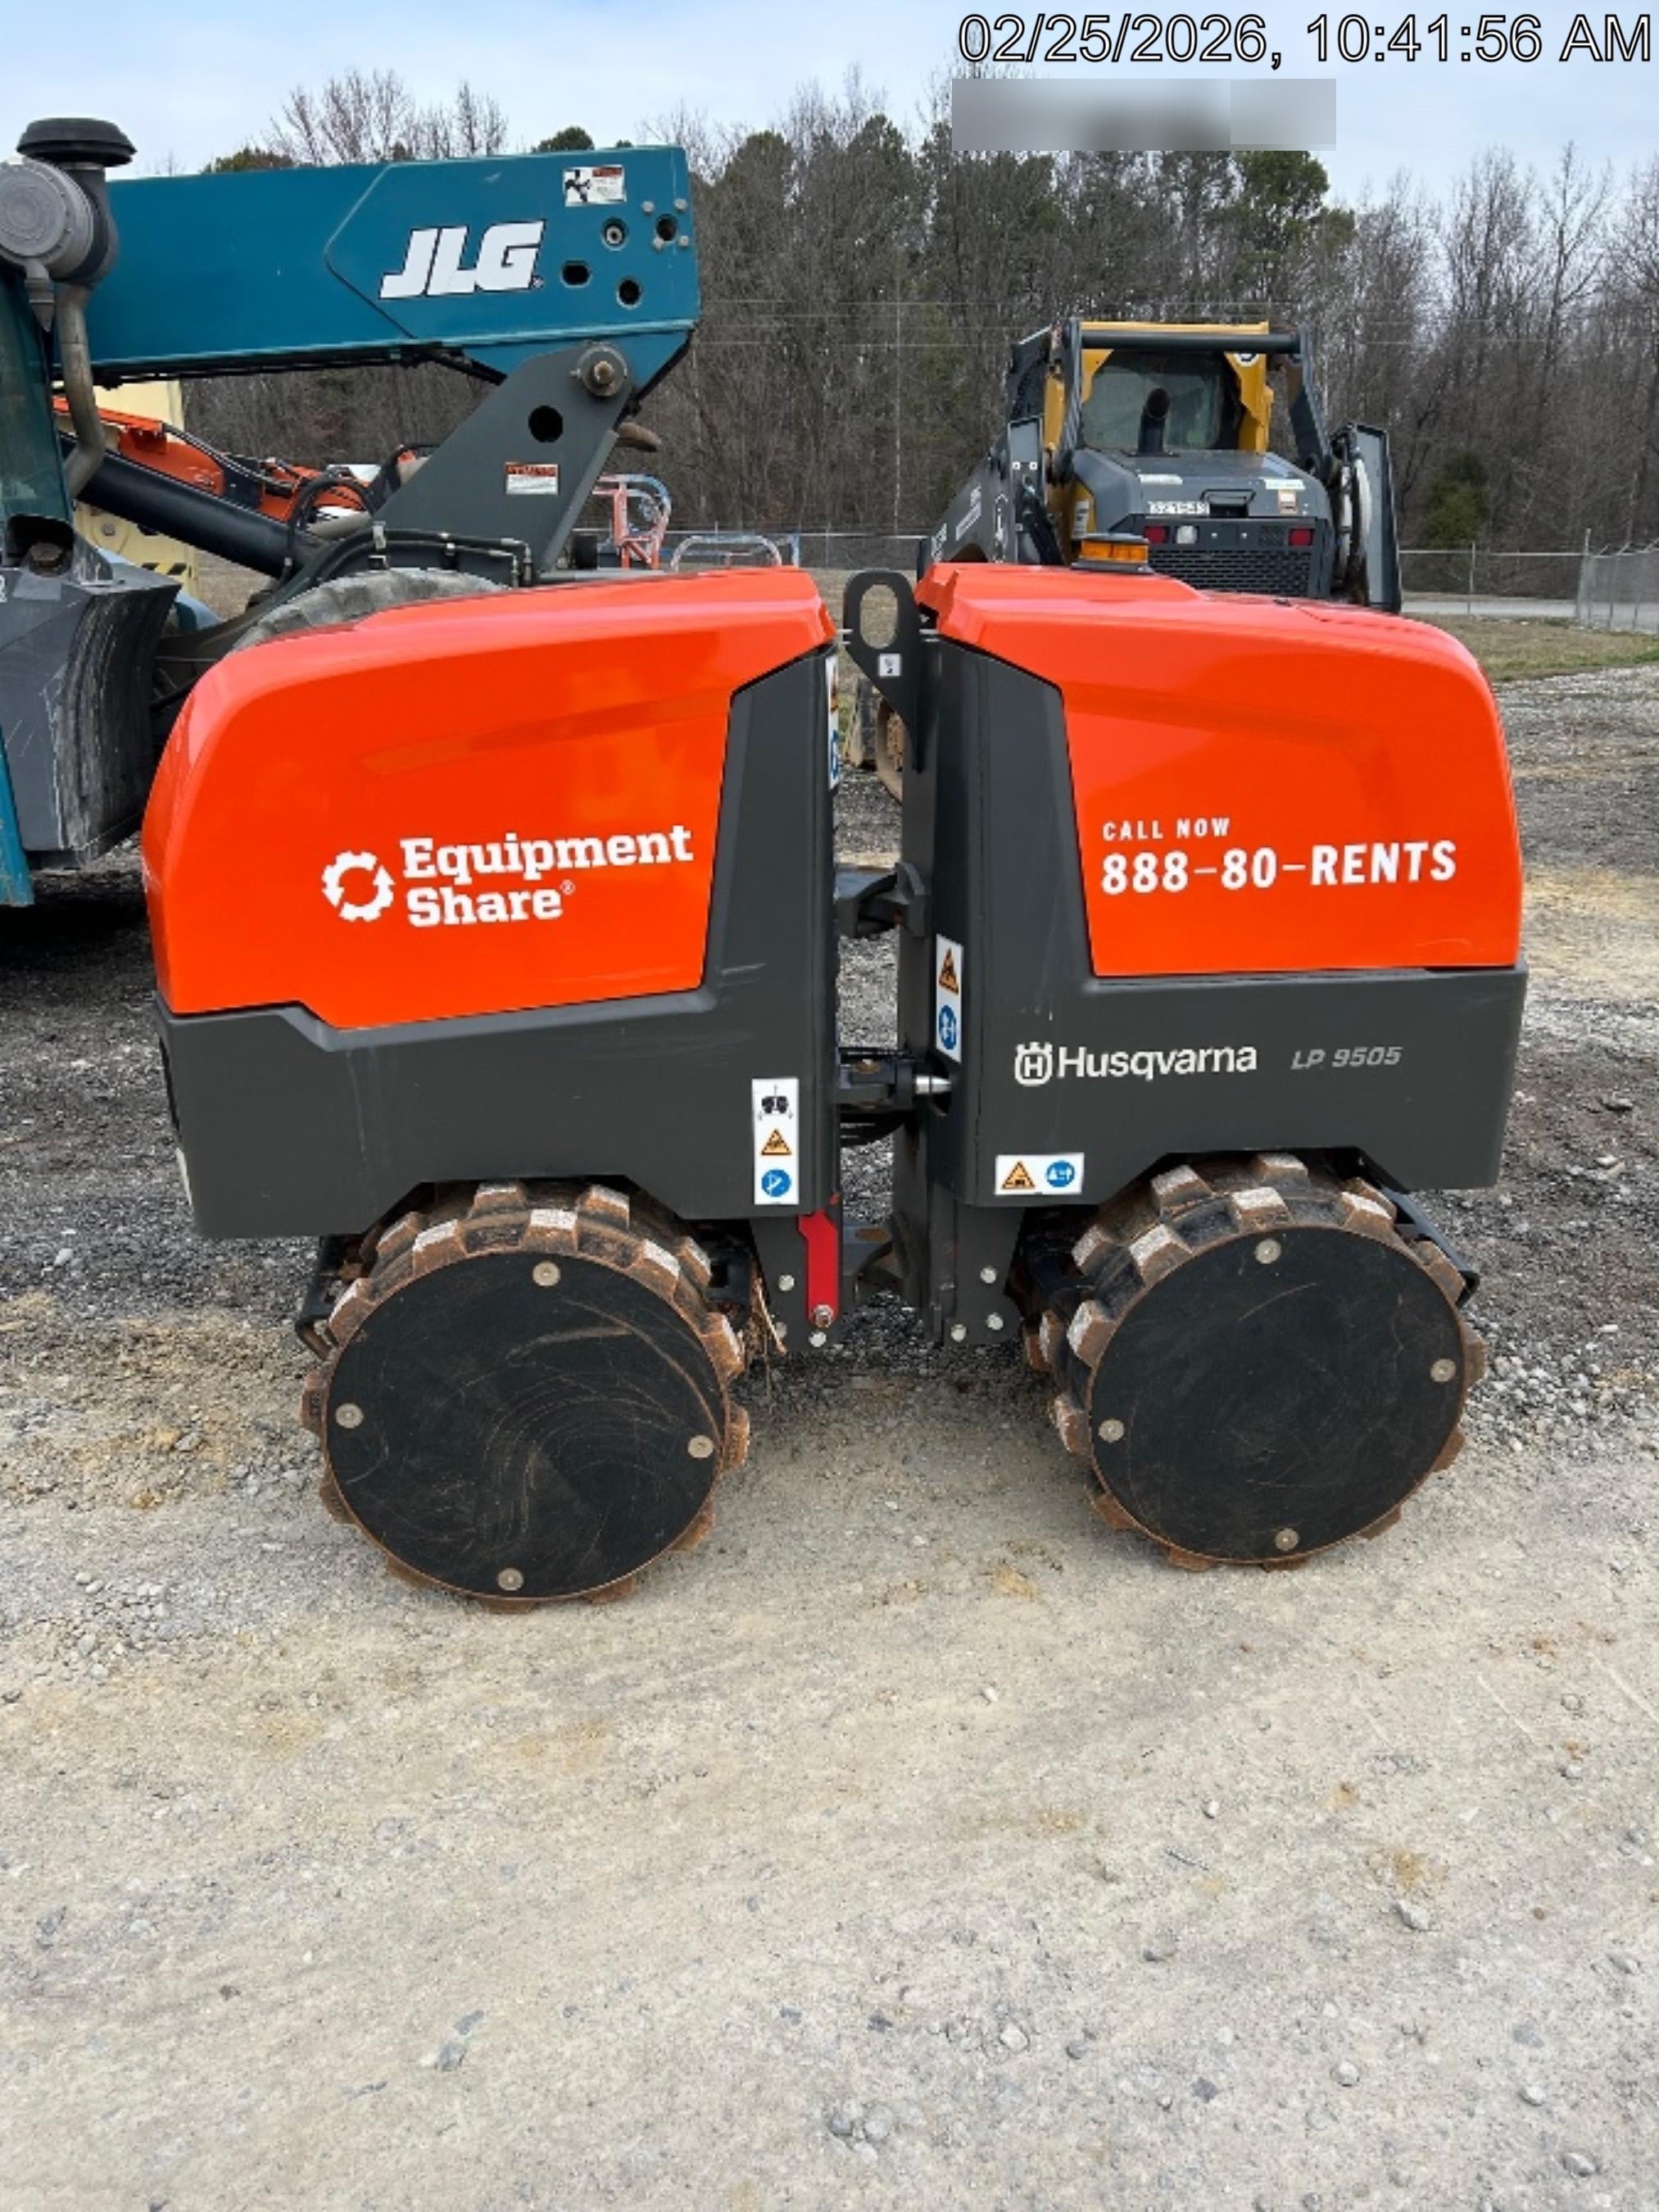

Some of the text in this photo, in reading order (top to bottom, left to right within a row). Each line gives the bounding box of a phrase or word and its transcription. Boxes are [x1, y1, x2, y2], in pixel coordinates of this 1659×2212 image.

[379, 220, 544, 298] JLG
[400, 825, 694, 885] Equipment
[1102, 818, 1230, 841] CALL NOW
[1101, 840, 1457, 895] 888-80-RENTS
[1058, 1045, 1403, 1081] Husqvarna LP 9505
